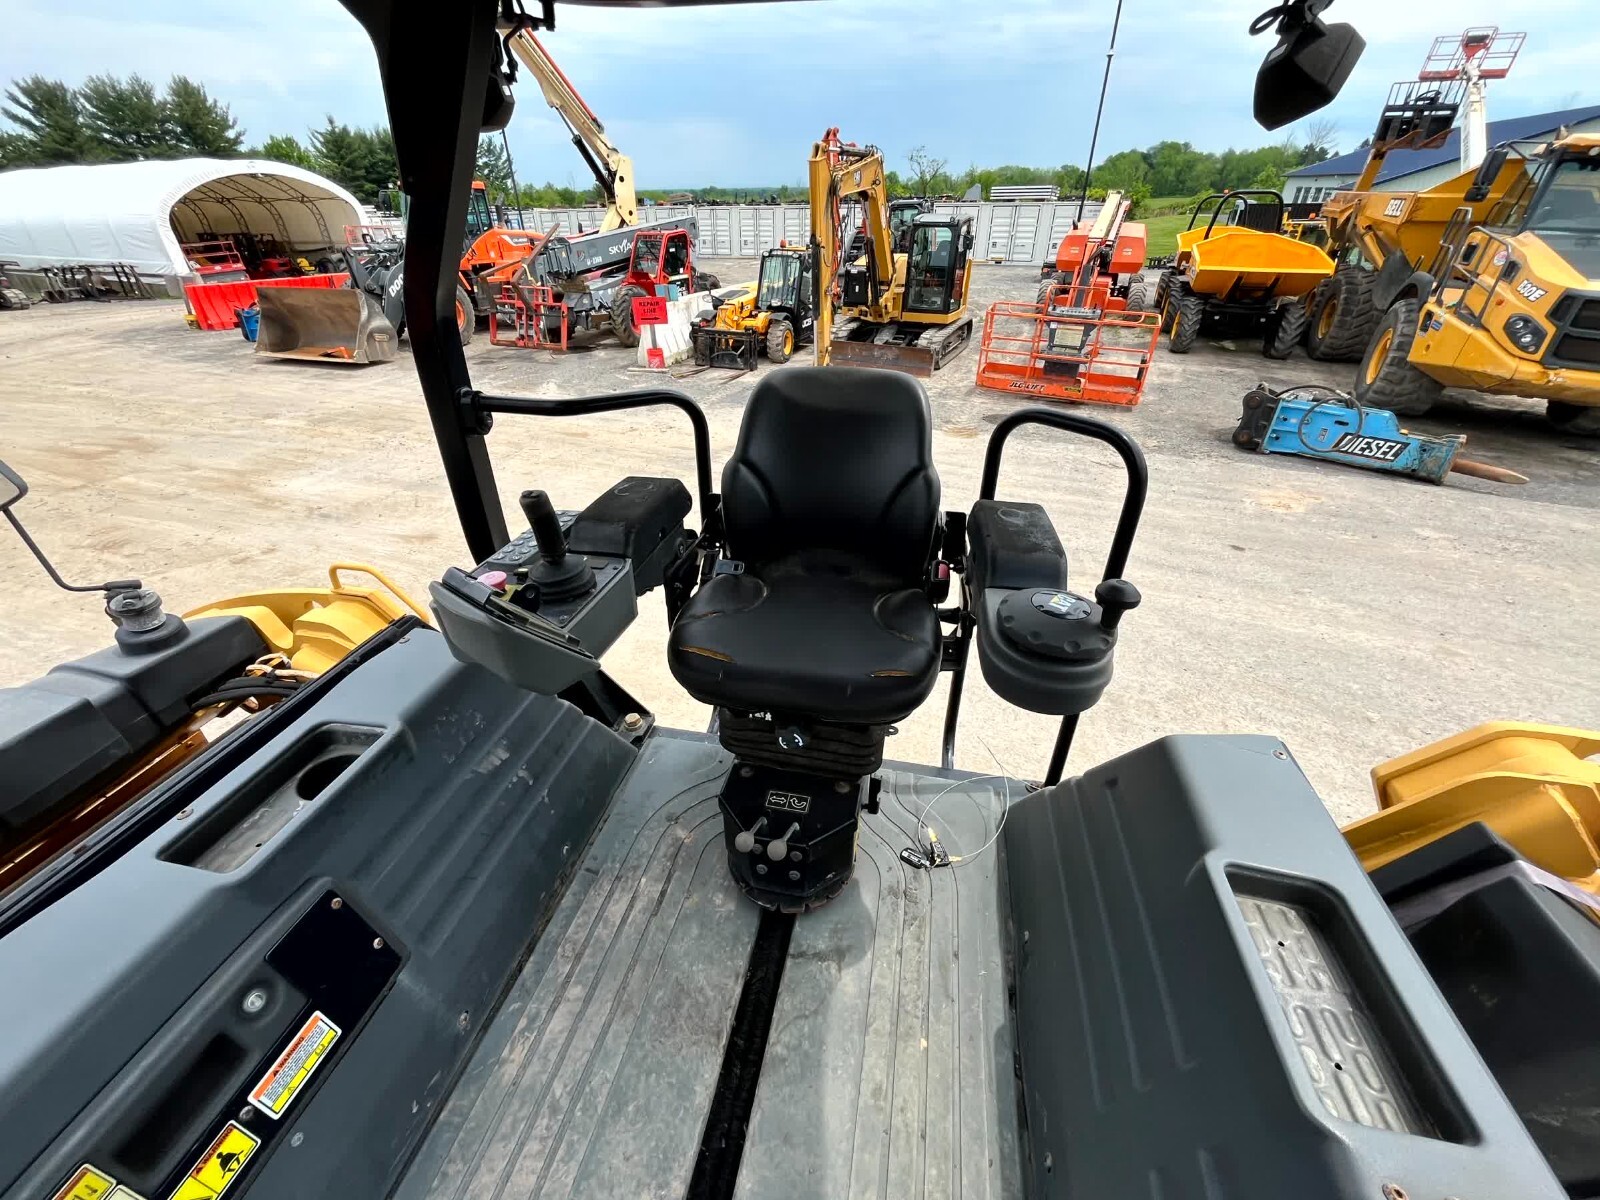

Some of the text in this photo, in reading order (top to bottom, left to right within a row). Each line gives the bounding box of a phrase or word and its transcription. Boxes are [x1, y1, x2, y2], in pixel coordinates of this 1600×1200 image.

[1383, 199, 1406, 217] BELL
[801, 318, 812, 328] JCB
[1338, 435, 1402, 460] DIESEL
[278, 1036, 305, 1068] WARNING
[202, 1127, 233, 1166] WARNING
